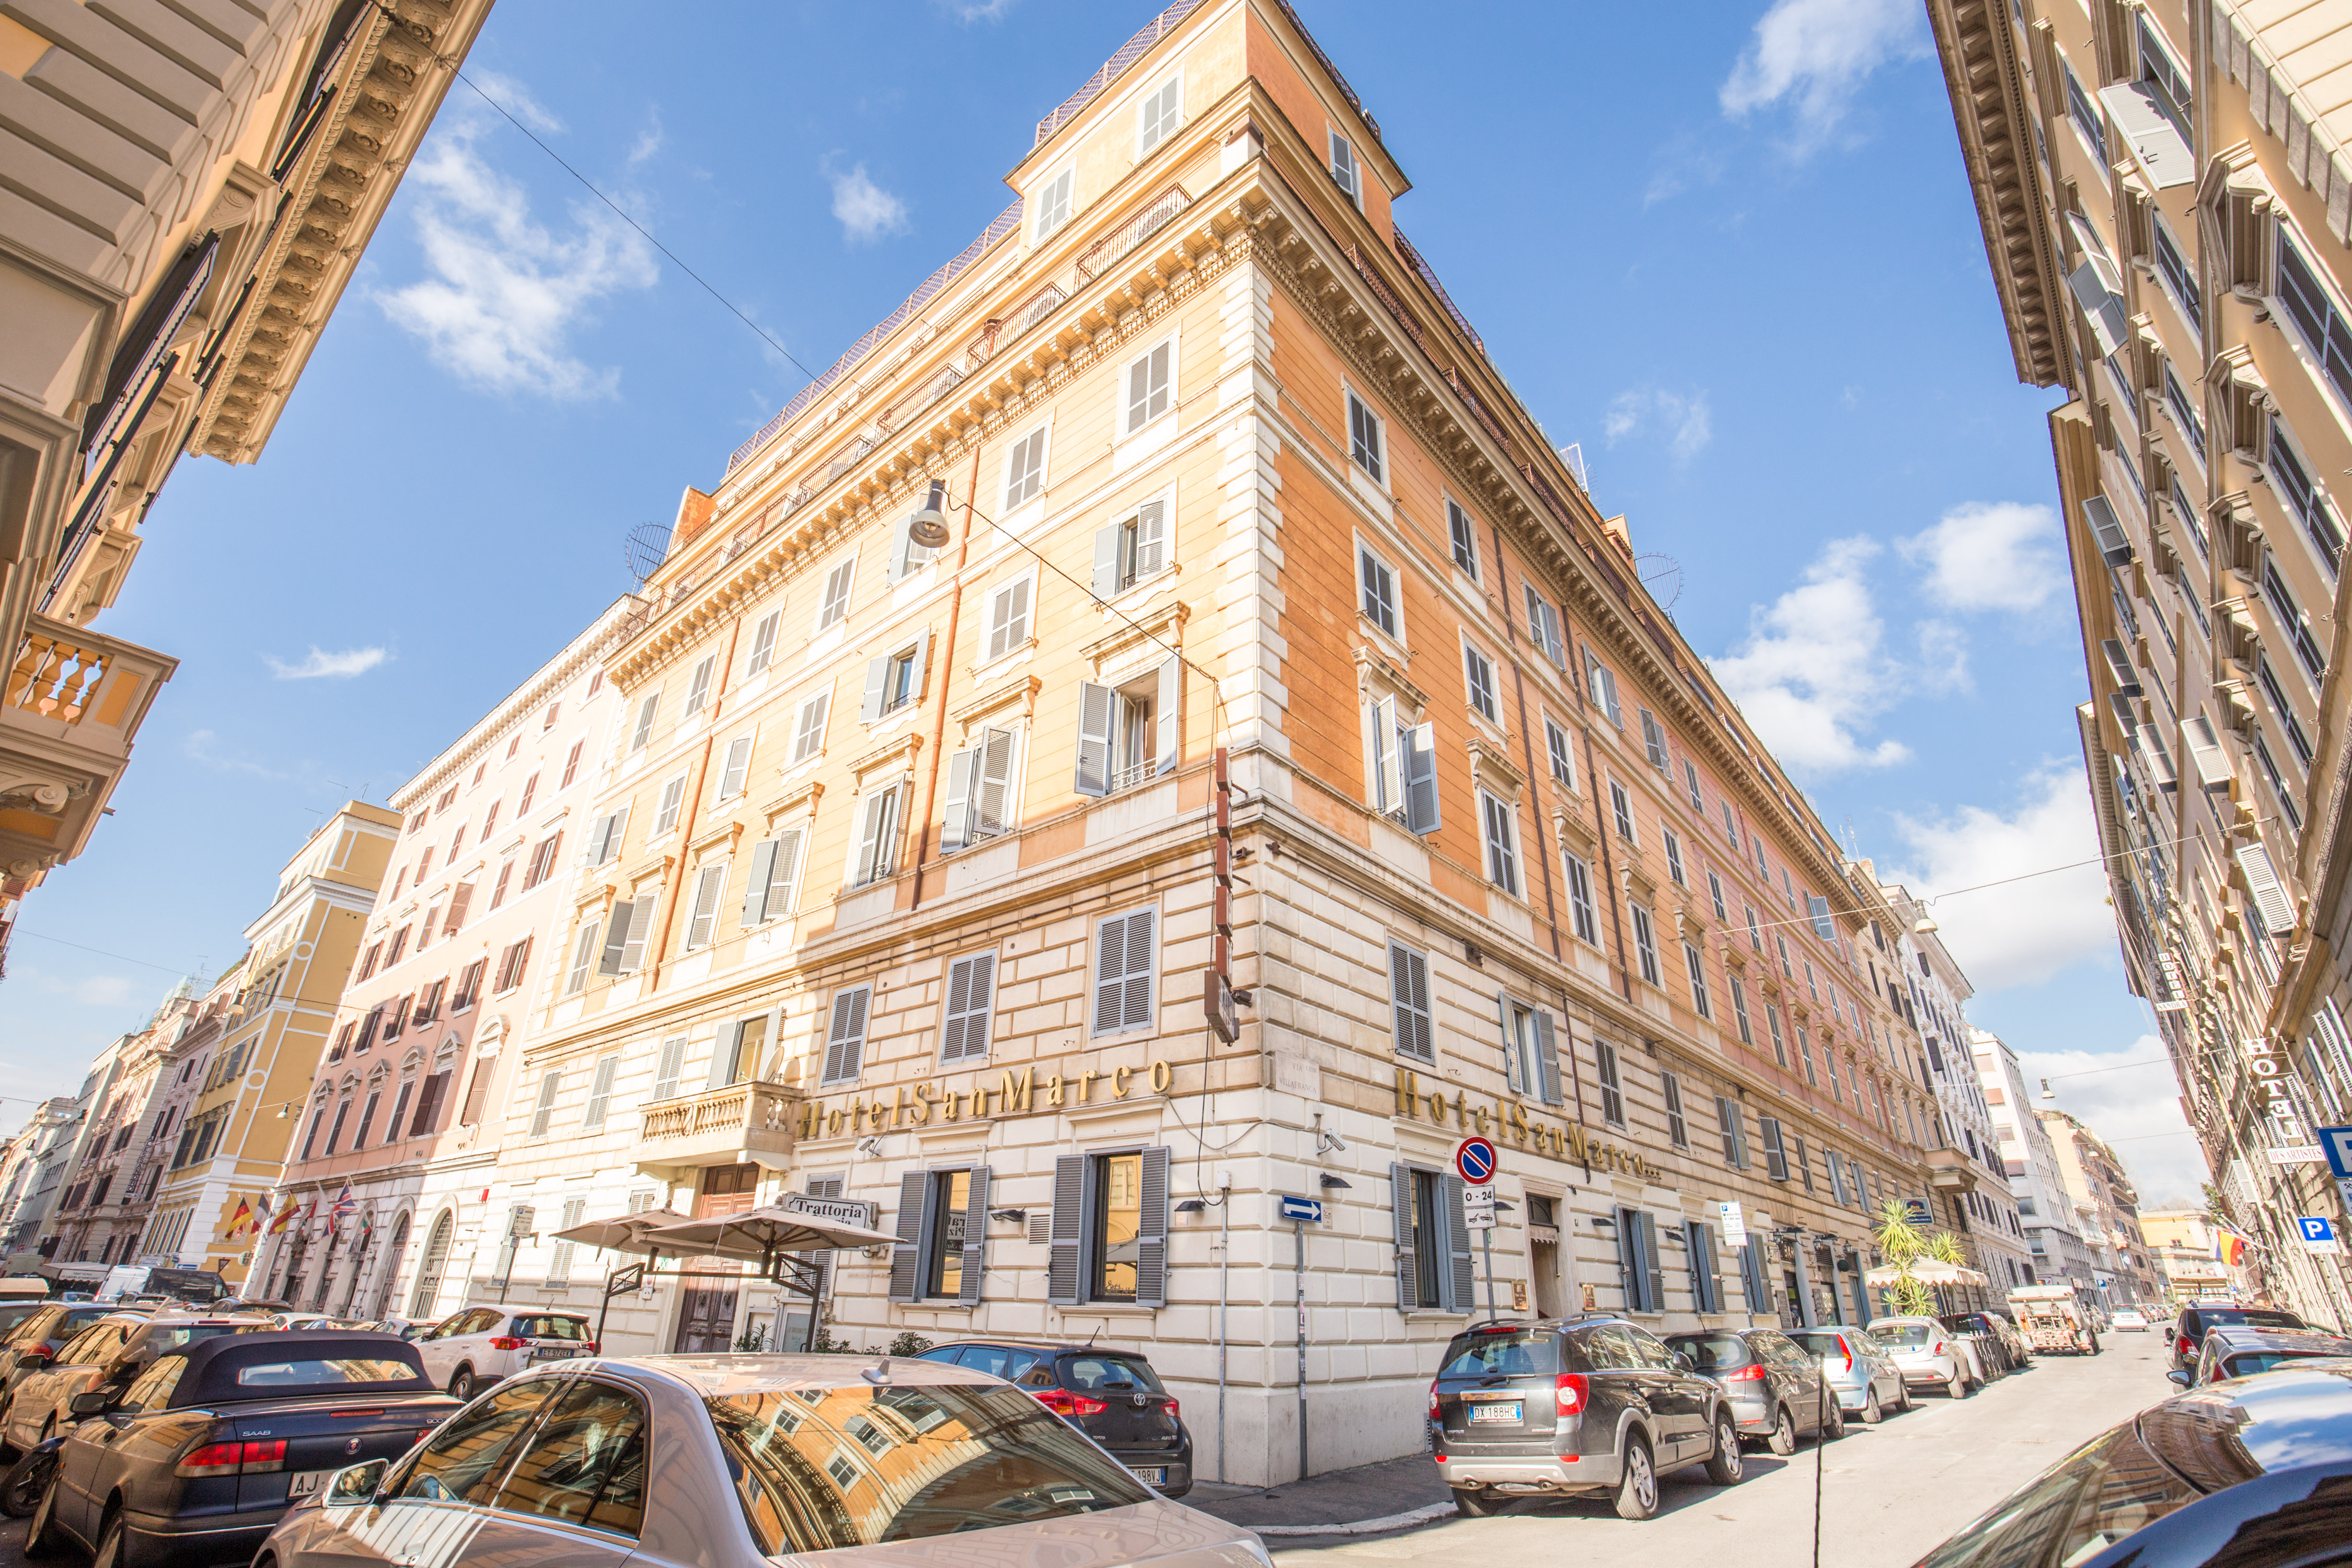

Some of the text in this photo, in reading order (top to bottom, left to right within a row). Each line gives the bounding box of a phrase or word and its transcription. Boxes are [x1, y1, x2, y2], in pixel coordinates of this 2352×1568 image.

[2158, 1001, 2186, 1010] SANDRA
[2269, 1148, 2323, 1161] DES ARTISTES
[128, 1136, 153, 1192] ALESSANDRO
[1482, 1191, 1492, 1201] 24
[795, 1200, 862, 1218] Trattoria
[1784, 1245, 1794, 1259] BAR
[1474, 1406, 1515, 1417] DX 188HC
[1138, 1469, 1161, 1482] 198VJ
[294, 1473, 320, 1494] AJ
[837, 1514, 885, 1525] NOLEGGIO
